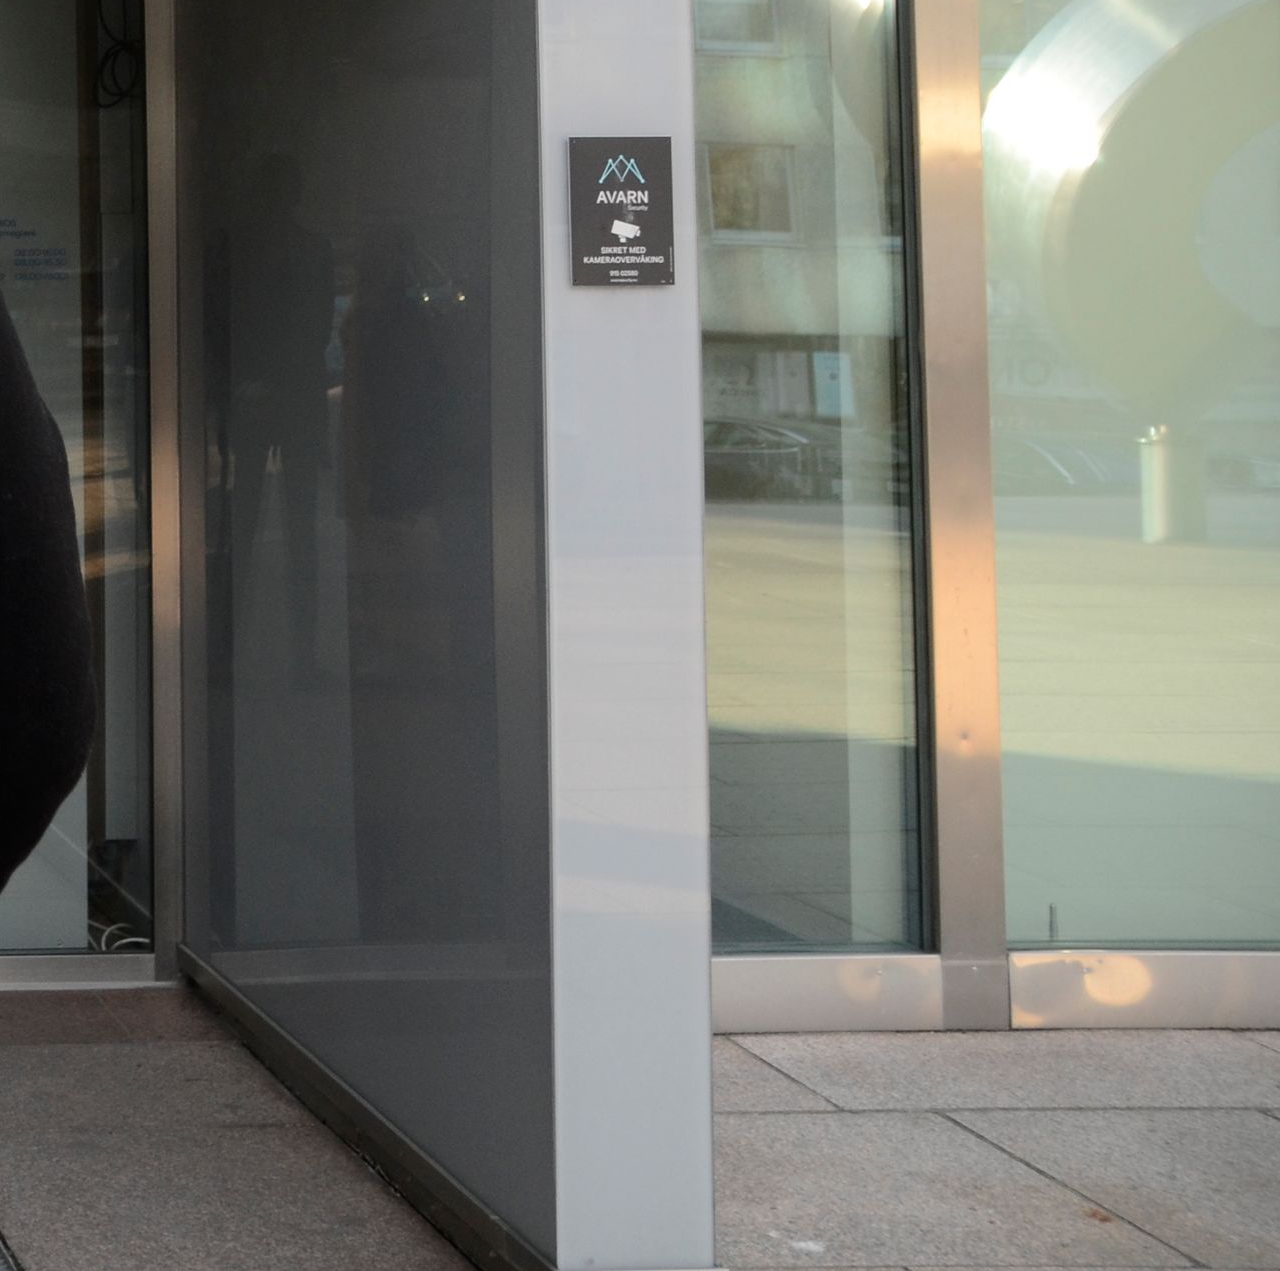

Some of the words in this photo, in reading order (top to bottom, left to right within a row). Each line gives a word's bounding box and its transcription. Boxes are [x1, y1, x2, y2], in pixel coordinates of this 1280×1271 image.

[596, 190, 649, 204] AVARN
[601, 246, 628, 254] SIKRET
[629, 246, 646, 254] MED
[583, 255, 665, 264] KAMERAOVERVÅKING
